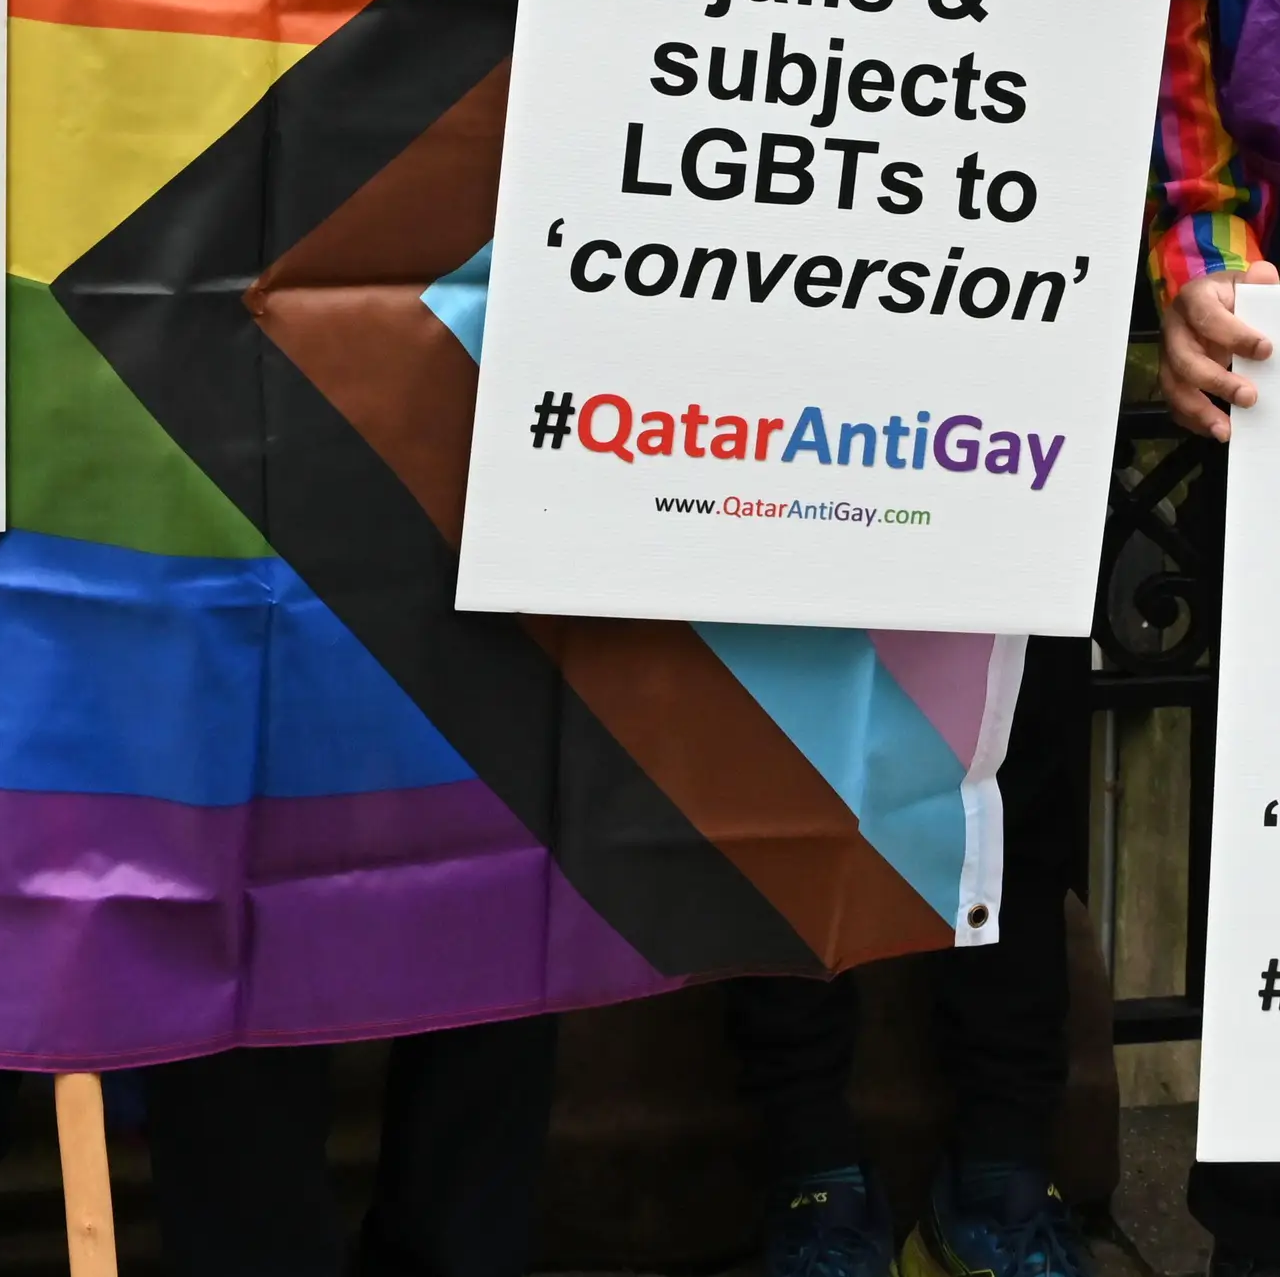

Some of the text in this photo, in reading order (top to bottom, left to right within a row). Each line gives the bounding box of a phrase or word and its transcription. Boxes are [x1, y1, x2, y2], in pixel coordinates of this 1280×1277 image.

[649, 31, 1027, 129] subjects
[621, 122, 1038, 224] LGBTs to
[546, 217, 1090, 323] ‘conversion’
[529, 390, 1066, 491] #QatarAntiGay
[653, 493, 932, 529] www.QatarAntiGay.com
